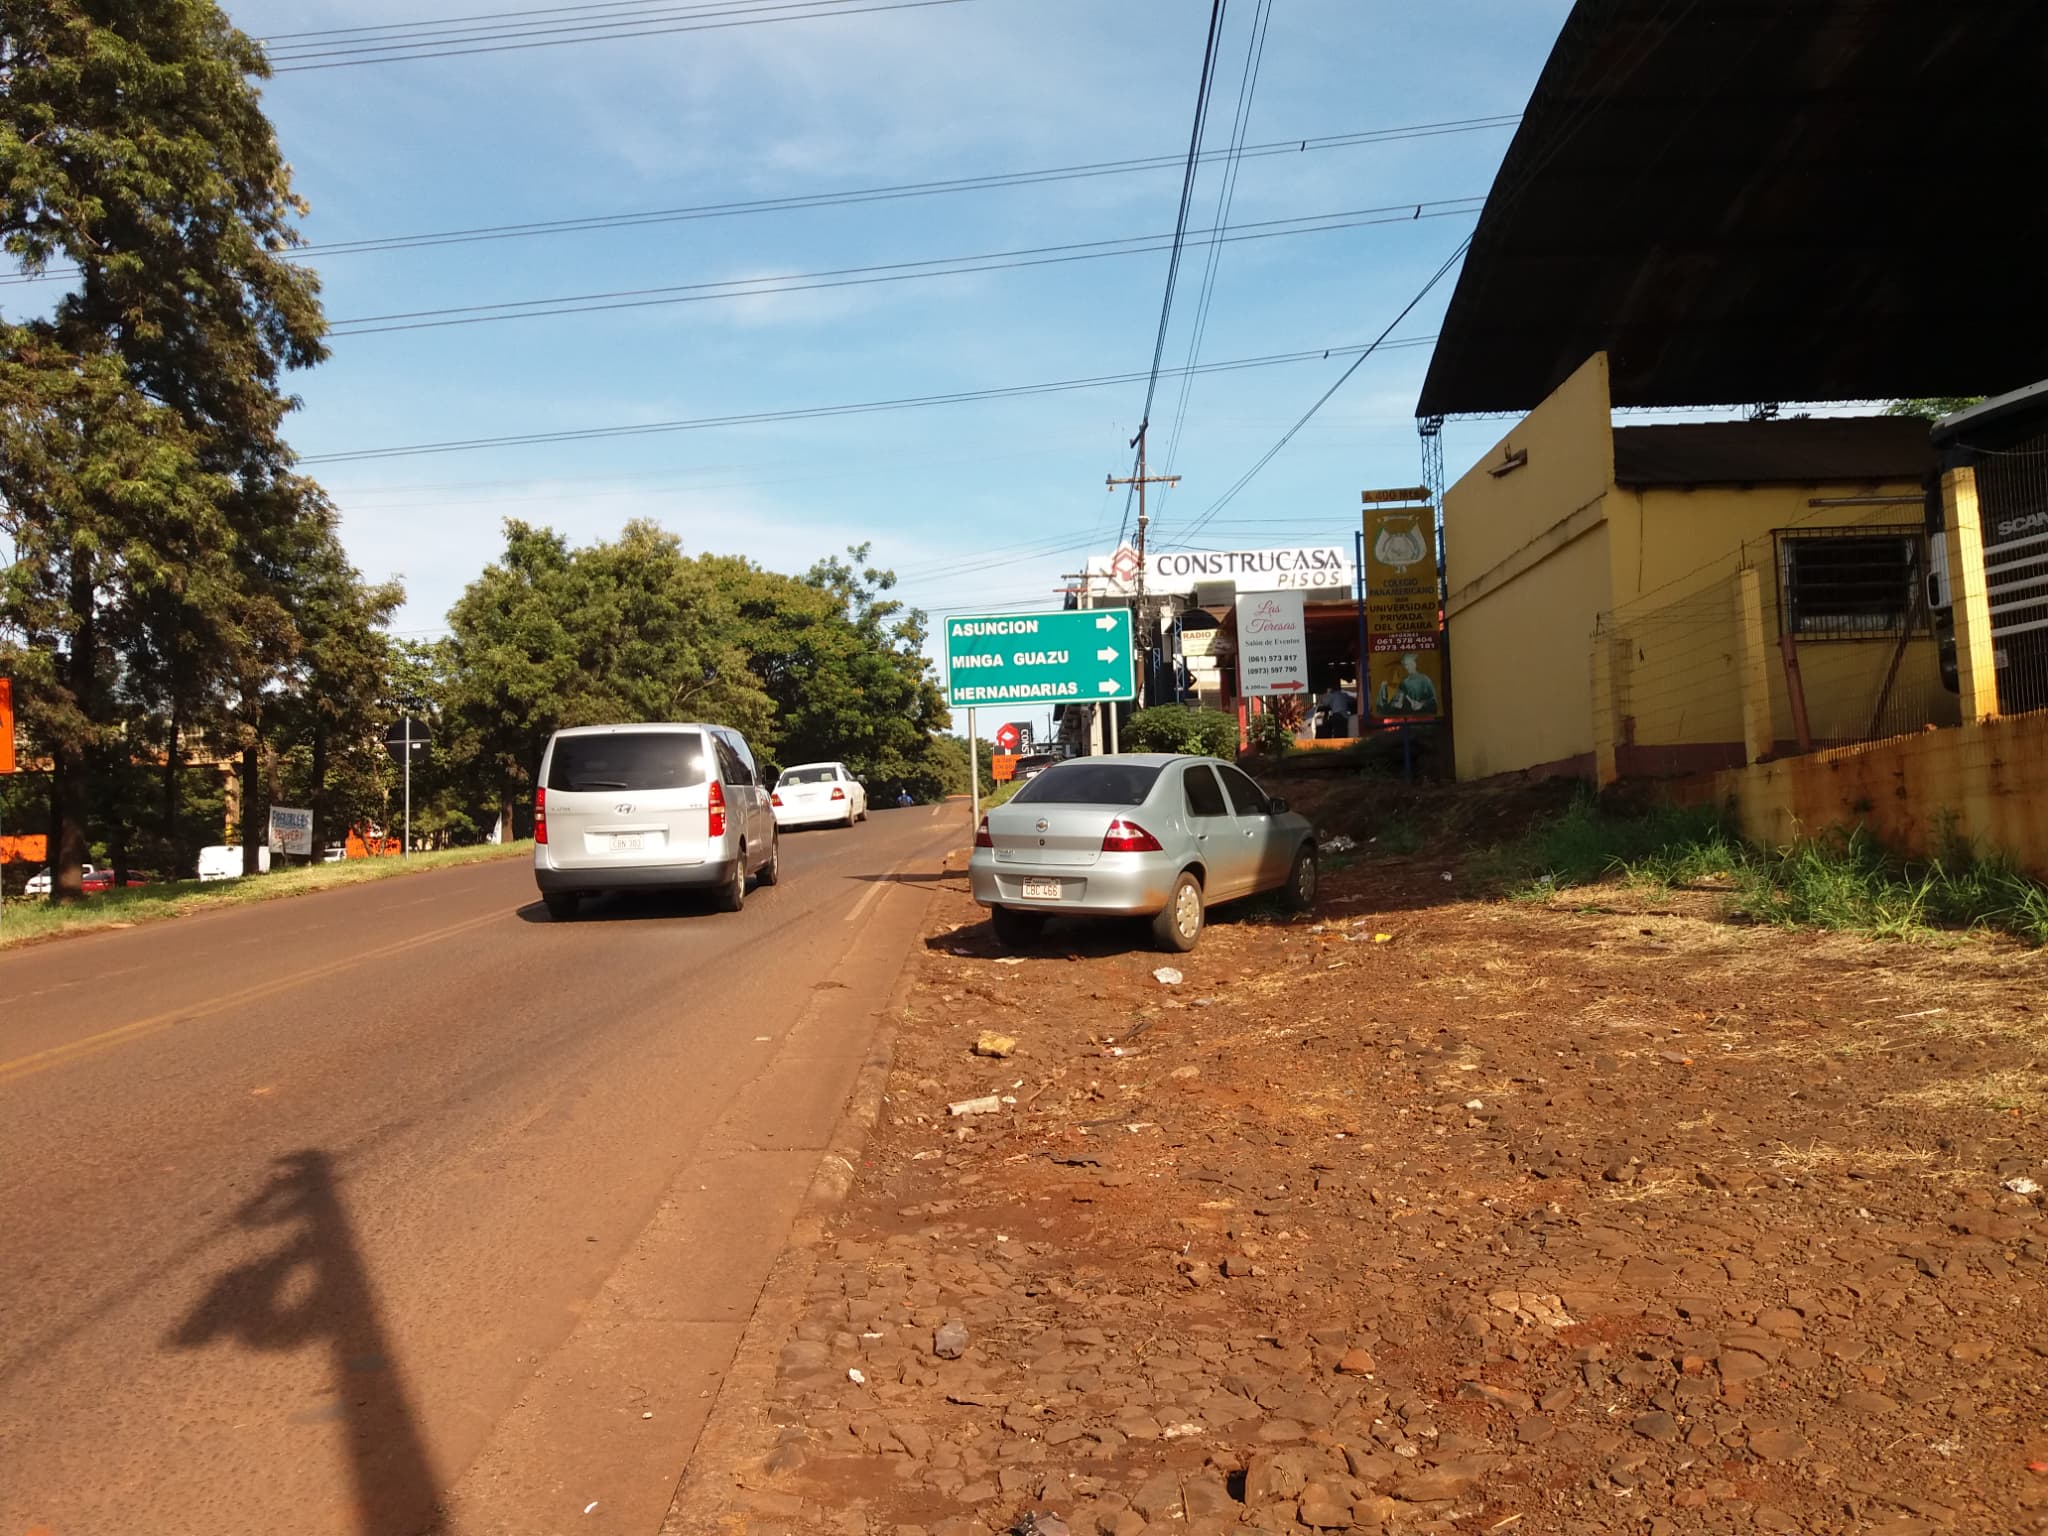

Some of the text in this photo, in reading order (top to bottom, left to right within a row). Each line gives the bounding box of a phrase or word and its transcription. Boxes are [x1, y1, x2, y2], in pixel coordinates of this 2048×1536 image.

[1157, 550, 1342, 576] CONSTRUCASA
[1278, 571, 1340, 587] PISOS
[1253, 600, 1280, 617] Las
[1369, 602, 1436, 613] UNIVERSIDAD
[1380, 613, 1423, 622] PRIVADA
[952, 620, 1039, 637] ASUNCION
[1246, 618, 1296, 633] Teresas
[1374, 621, 1433, 632] DEL GUAIRA
[1183, 631, 1211, 640] RADIO
[1265, 638, 1273, 646] de
[952, 650, 1069, 669] MINGA GUAZU
[1248, 655, 1267, 663] (061)
[953, 682, 1078, 700] HERNANDARIAS
[1026, 884, 1040, 896] CBC
